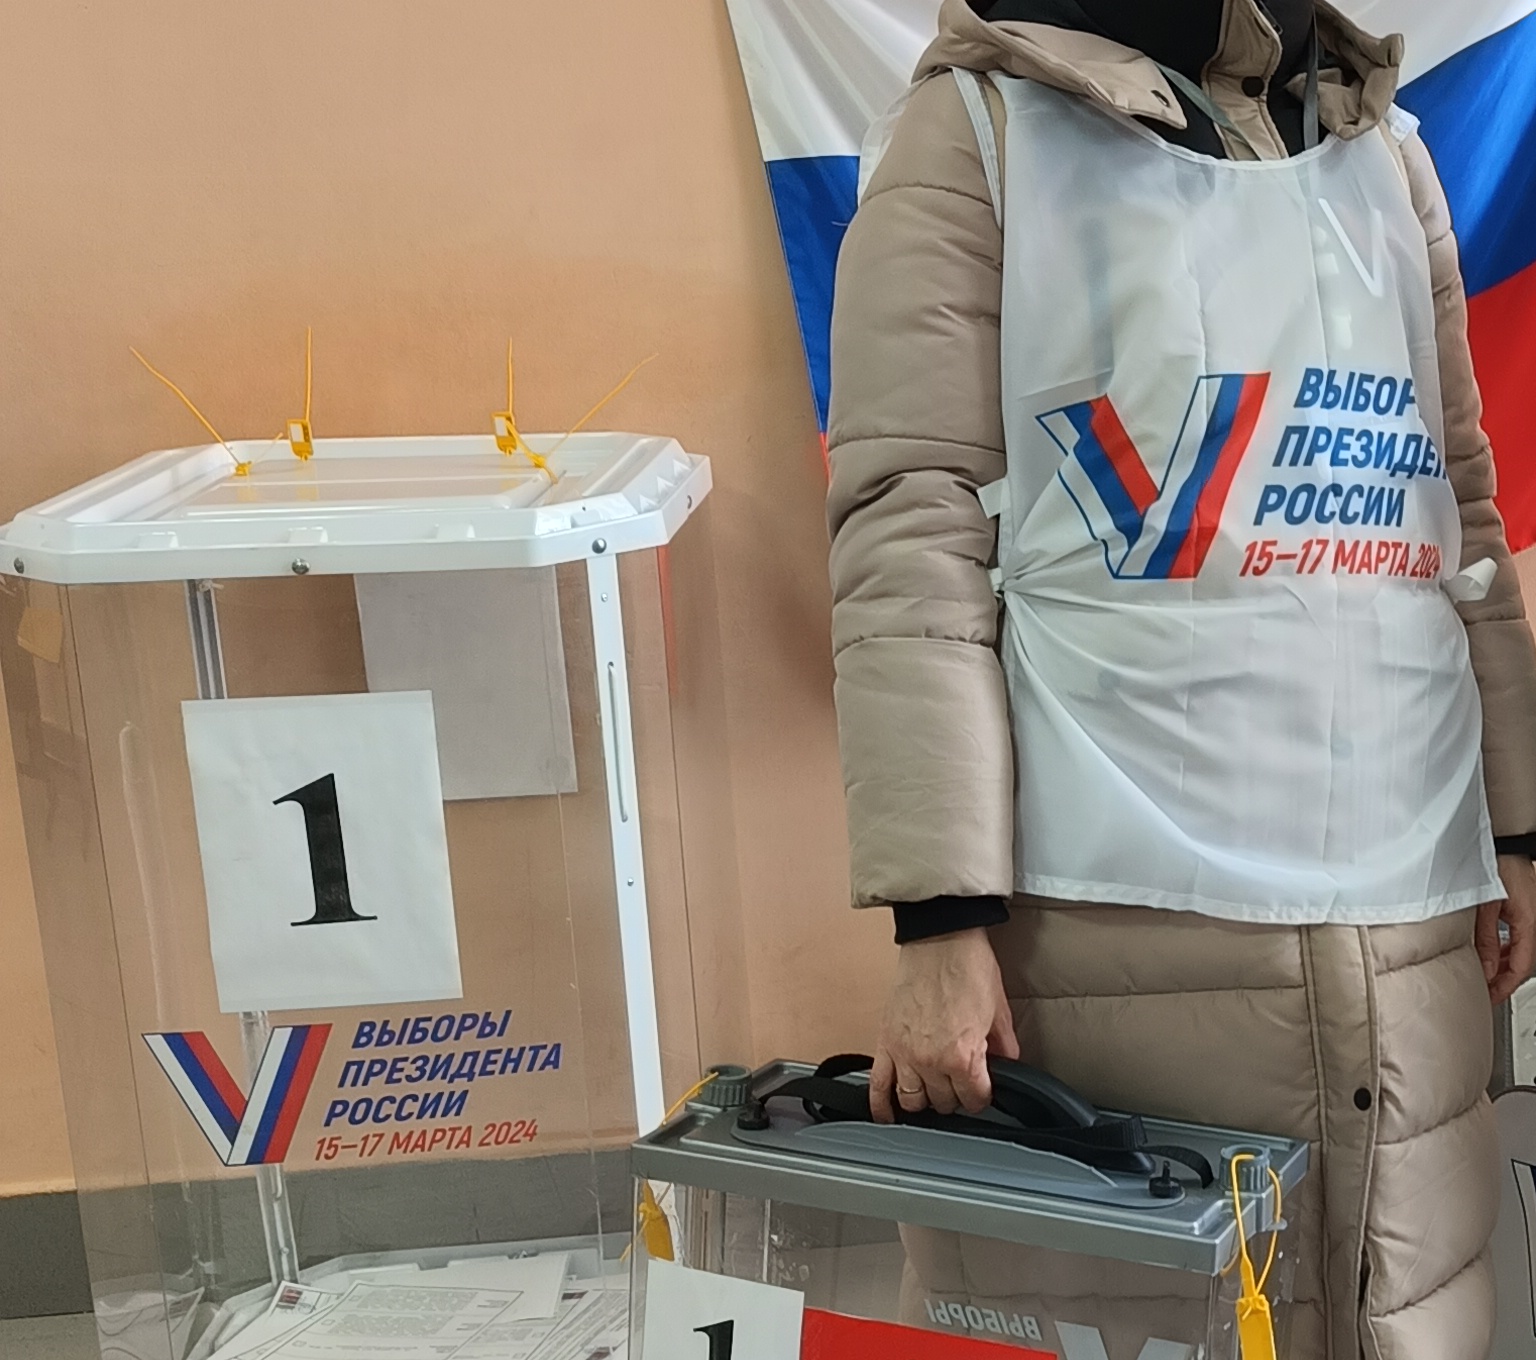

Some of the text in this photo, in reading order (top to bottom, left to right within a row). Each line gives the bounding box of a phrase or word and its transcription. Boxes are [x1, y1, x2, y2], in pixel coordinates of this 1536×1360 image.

[1293, 367, 1417, 417] ВЫБОР
[1272, 425, 1447, 480] ПРЕЗИДЕ
[1252, 482, 1406, 528] РОССИИ
[1331, 539, 1411, 577] МАРТА
[272, 772, 378, 927] 1
[350, 1009, 512, 1050] ВЫБОРЫ
[337, 1042, 563, 1089] ПРЕЗИДЕНТА
[323, 1090, 469, 1128] РОССИИ
[386, 1126, 473, 1157] МАРТА
[477, 1118, 539, 1148] 2024
